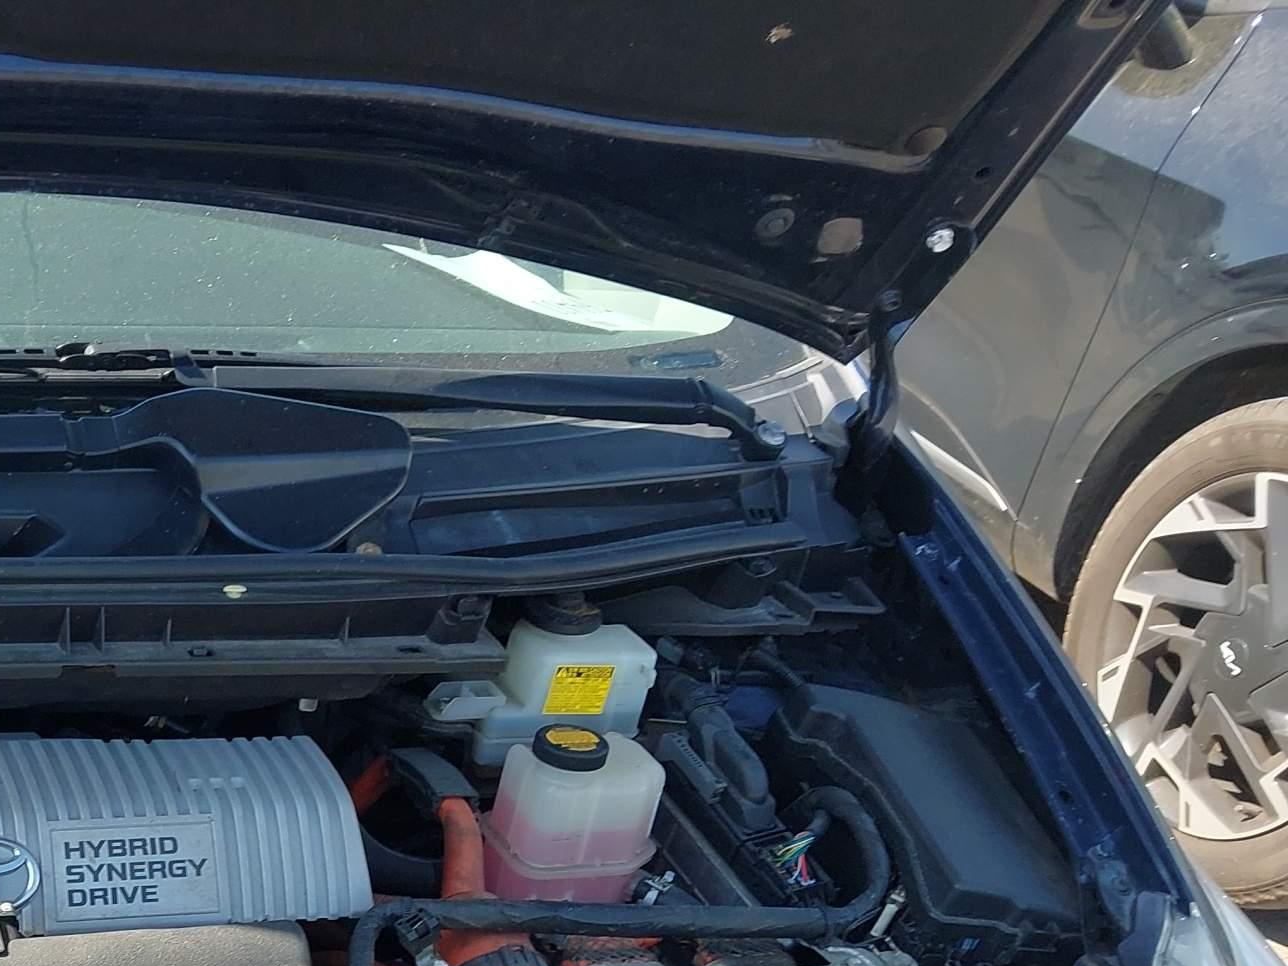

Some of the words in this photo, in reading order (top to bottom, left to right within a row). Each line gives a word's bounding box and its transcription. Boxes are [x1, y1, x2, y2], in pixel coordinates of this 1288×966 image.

[64, 836, 179, 859] HYBRID
[65, 858, 209, 884] SYNERGY
[67, 884, 160, 907] DRIVE
